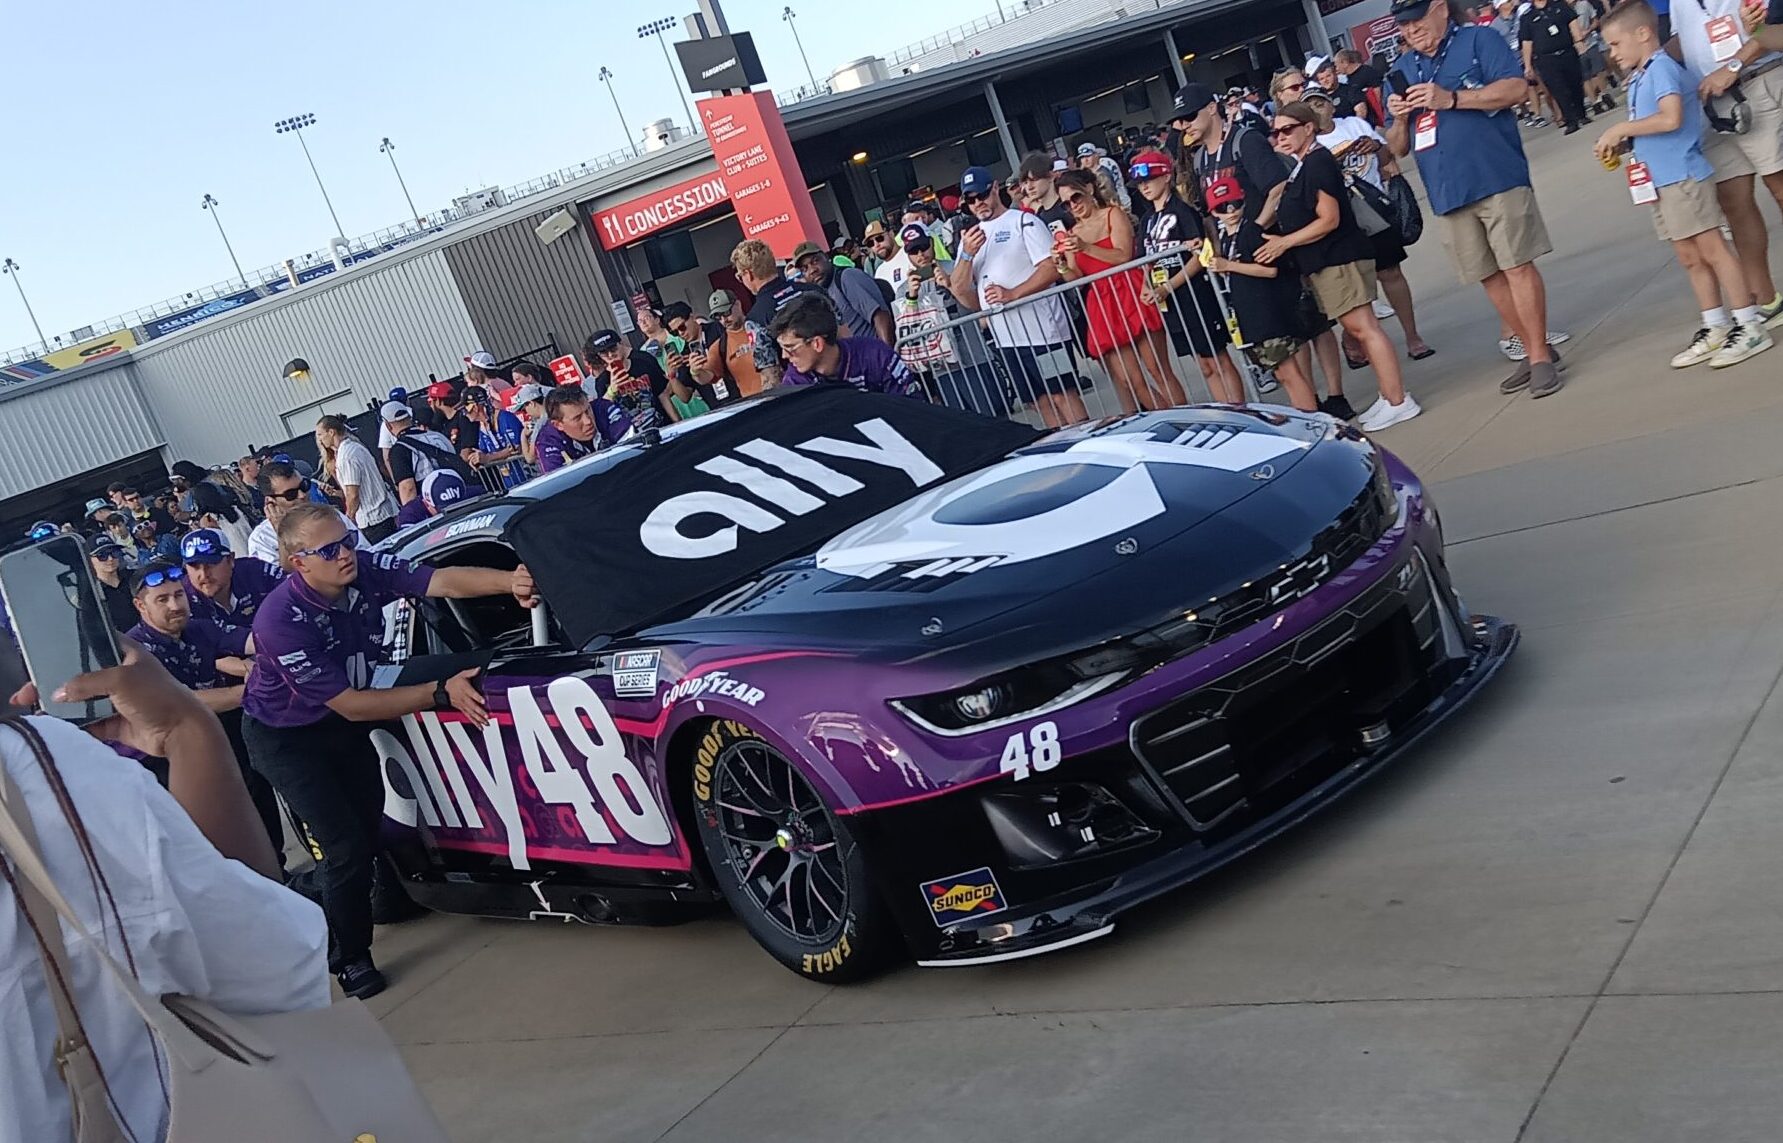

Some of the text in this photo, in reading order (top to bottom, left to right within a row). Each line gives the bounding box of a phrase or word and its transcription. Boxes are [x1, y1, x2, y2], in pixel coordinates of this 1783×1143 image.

[722, 144, 764, 167] VICTORY LANE
[726, 163, 742, 176] CLUB
[746, 153, 768, 168] SUITES
[734, 183, 760, 200] GARAGES
[624, 176, 729, 236] CONCESSION
[748, 217, 775, 236] GARAGES
[440, 486, 460, 501] ally
[640, 417, 946, 560] ally
[445, 513, 497, 539] BOWMAN
[627, 653, 654, 669] NASCAR
[619, 673, 651, 687] CUP SERIES
[662, 671, 766, 708] GOODYEAR
[694, 719, 768, 801] GOODYE
[1000, 721, 1062, 782] 48
[369, 676, 672, 871] ally 48
[936, 885, 993, 911] SUNOCO
[802, 933, 852, 974] EAGLE
